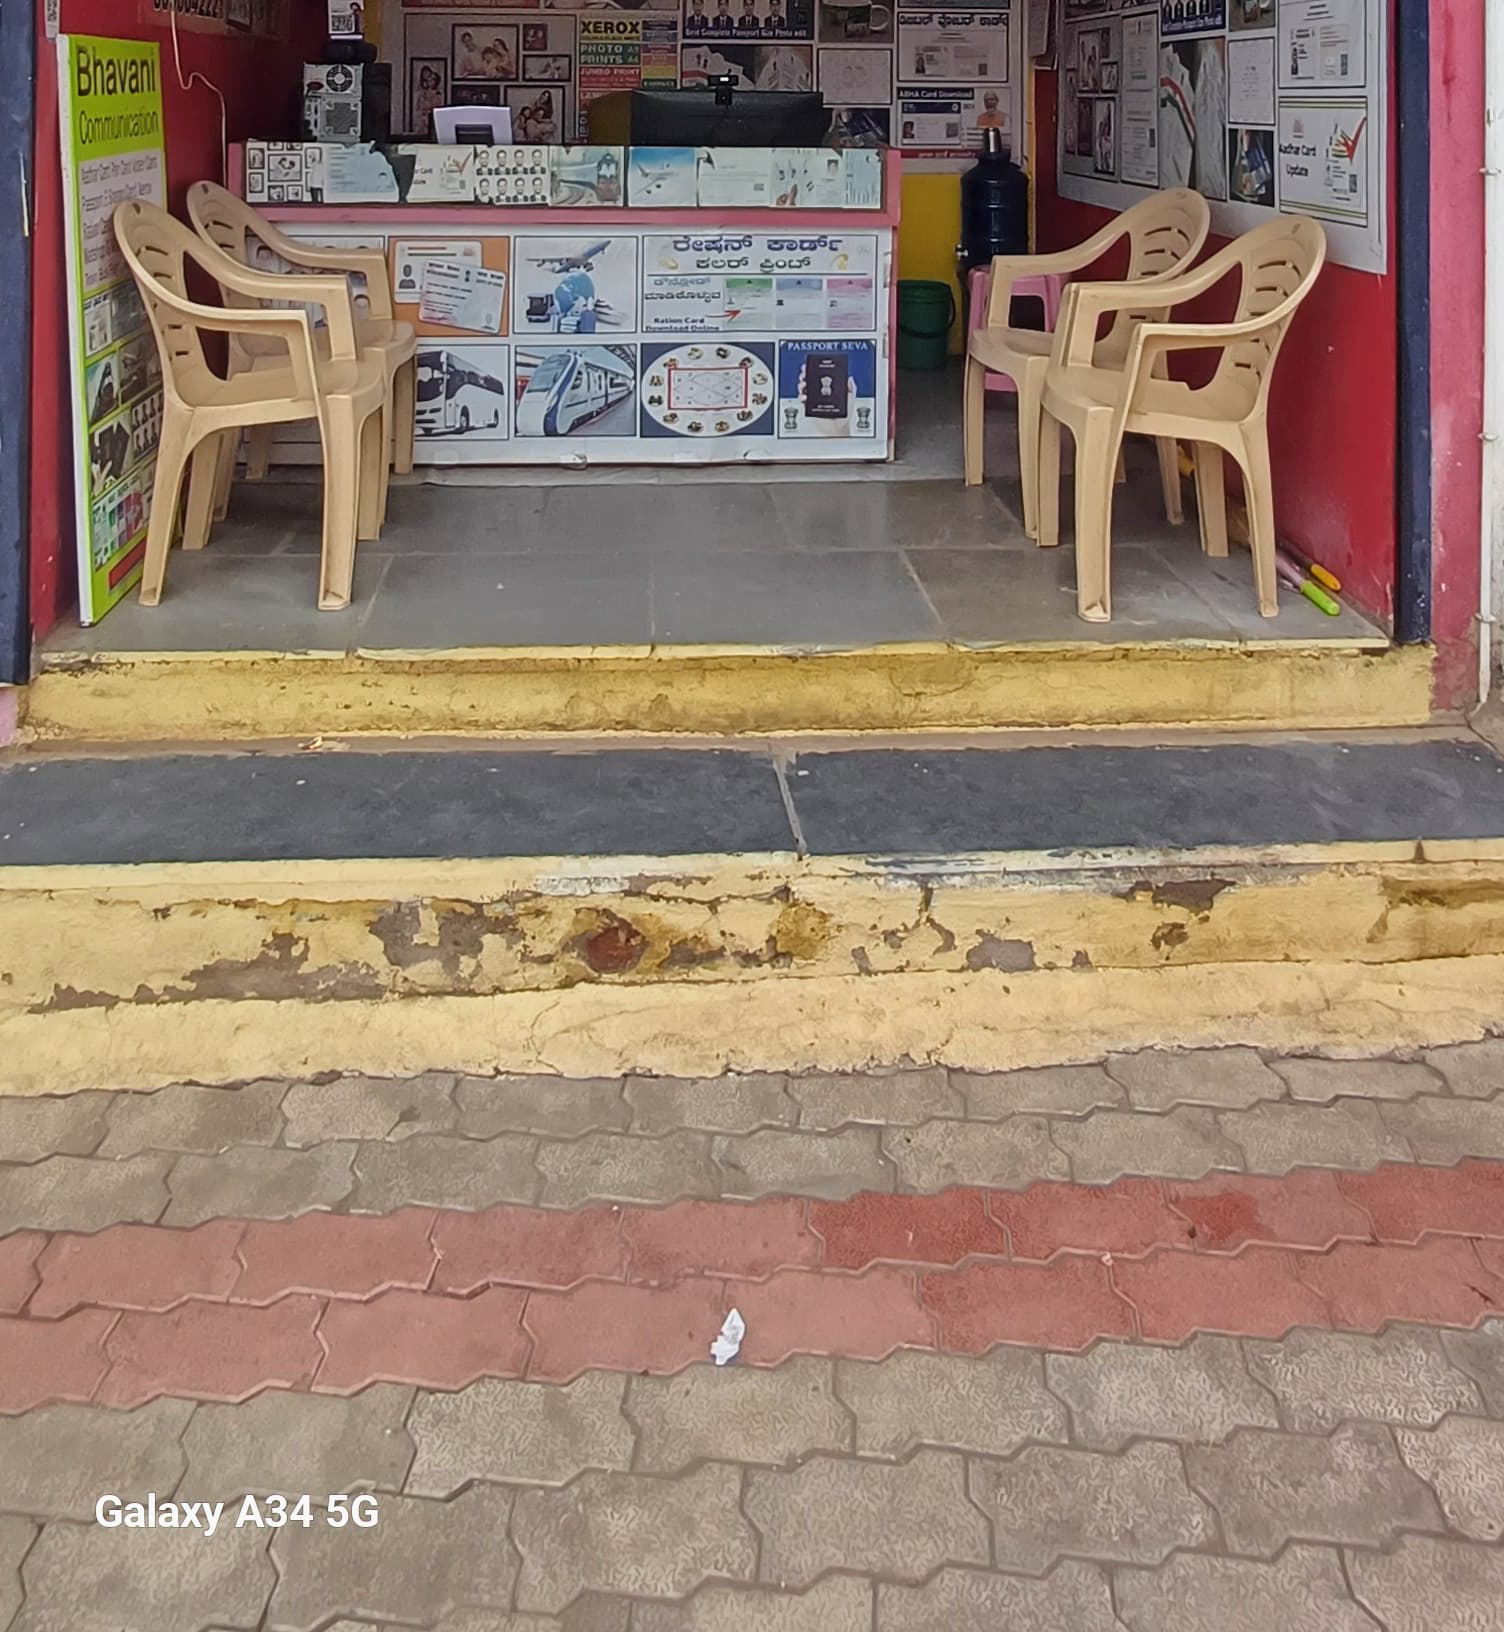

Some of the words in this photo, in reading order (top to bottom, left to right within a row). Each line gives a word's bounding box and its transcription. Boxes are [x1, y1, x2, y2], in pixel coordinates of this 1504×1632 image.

[581, 21, 640, 34] XEROX
[580, 45, 623, 54] PHOTO
[580, 55, 623, 65] PRINTS
[77, 45, 156, 97] Bhavani
[921, 90, 938, 98] Card
[79, 107, 159, 145] Communication
[673, 234, 752, 255] ರೇಷನ್
[696, 256, 749, 270] ಕಲರ್
[685, 317, 705, 325] Card
[788, 342, 840, 351] PASSPORT
[842, 342, 868, 351] SEVA
